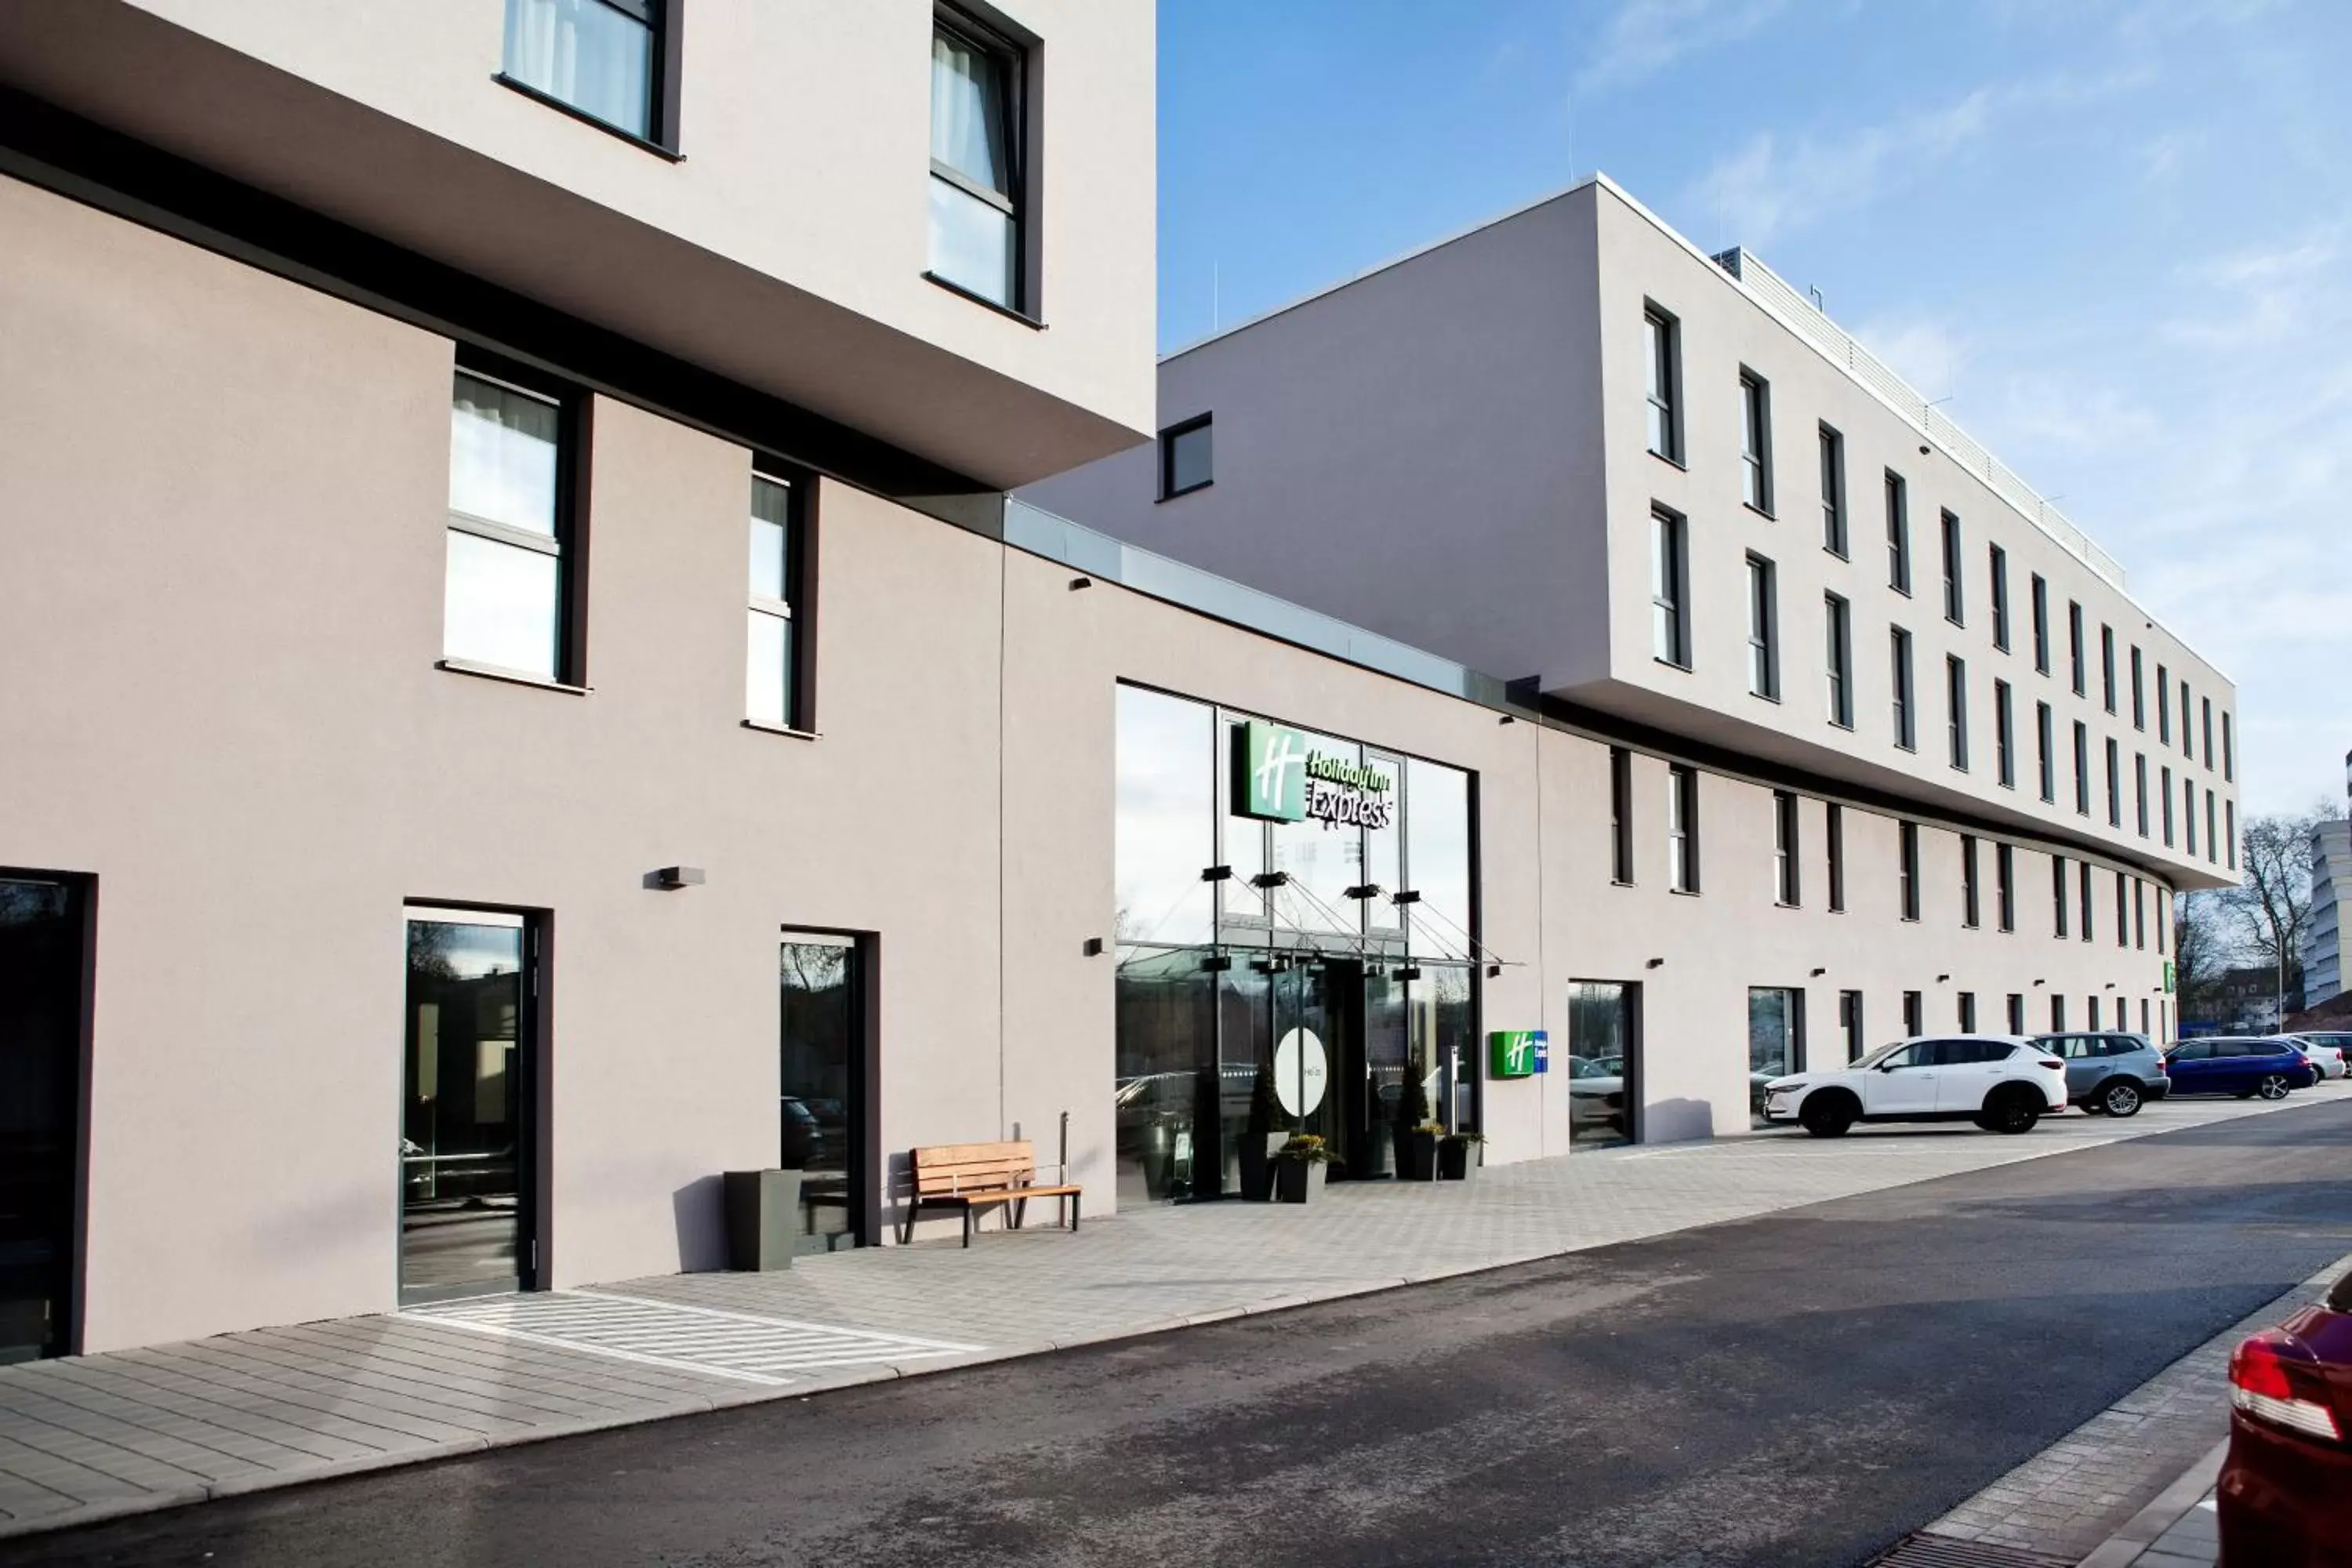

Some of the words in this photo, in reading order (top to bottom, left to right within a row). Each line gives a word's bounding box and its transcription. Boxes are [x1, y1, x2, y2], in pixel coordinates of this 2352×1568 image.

[1256, 733, 1305, 811] H
[1308, 750, 1368, 791] Holiday
[1369, 764, 1389, 791] Inn
[1311, 781, 1393, 830] Express
[1506, 1033, 1533, 1071] H
